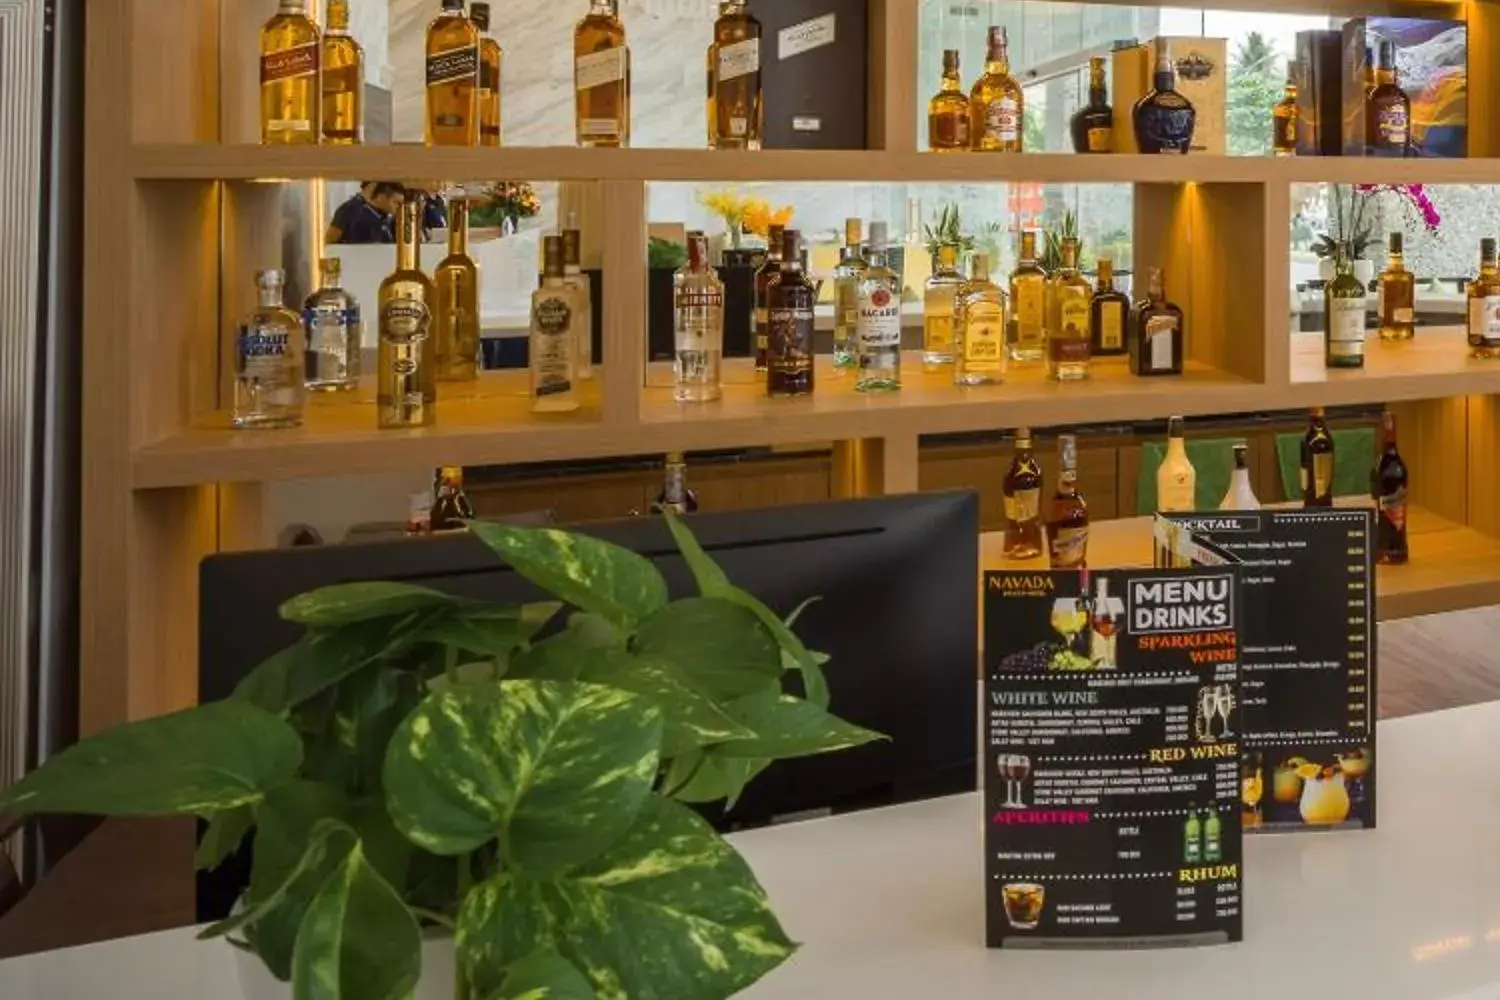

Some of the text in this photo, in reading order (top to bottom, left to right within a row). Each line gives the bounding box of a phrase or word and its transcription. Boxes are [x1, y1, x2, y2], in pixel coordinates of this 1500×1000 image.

[989, 575, 1056, 590] NAVADA
[1135, 578, 1228, 604] MENU
[1135, 604, 1228, 630] DRINKS
[1138, 631, 1237, 650] SPARKLING
[1190, 649, 1237, 664] WINE
[991, 689, 1099, 706] WHITE WINE
[1150, 743, 1238, 764] RED WINE
[1178, 864, 1238, 882] RHUM
